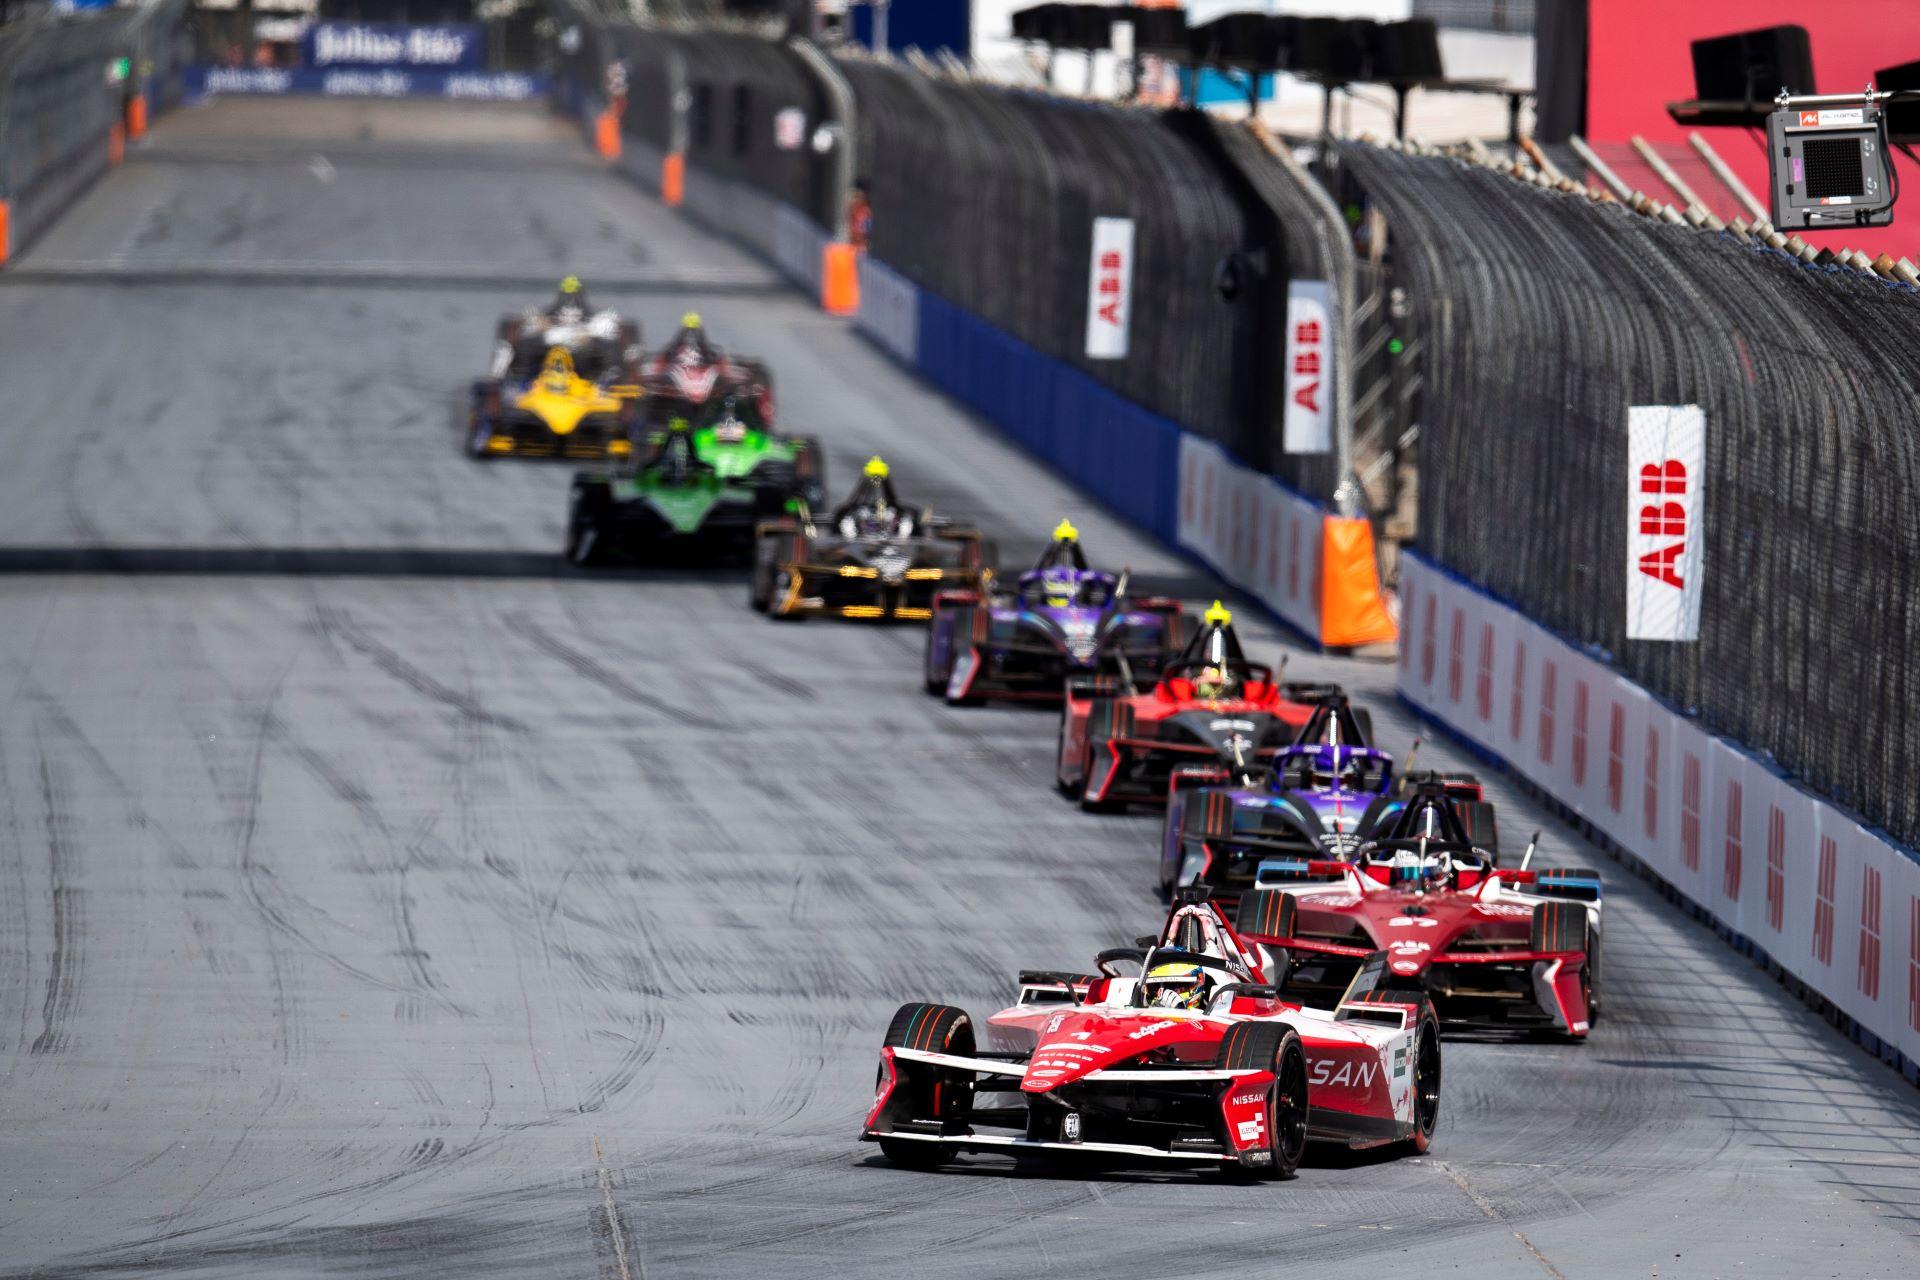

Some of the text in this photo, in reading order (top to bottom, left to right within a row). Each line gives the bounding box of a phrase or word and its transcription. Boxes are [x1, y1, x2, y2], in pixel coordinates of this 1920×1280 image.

[1098, 250, 1122, 326] ABB
[1292, 319, 1321, 413] ABB
[1638, 458, 1688, 590] ABB
[1033, 1060, 1081, 1070] ABB
[1304, 1058, 1379, 1088] SAN
[1232, 1093, 1264, 1106] NISSAN
